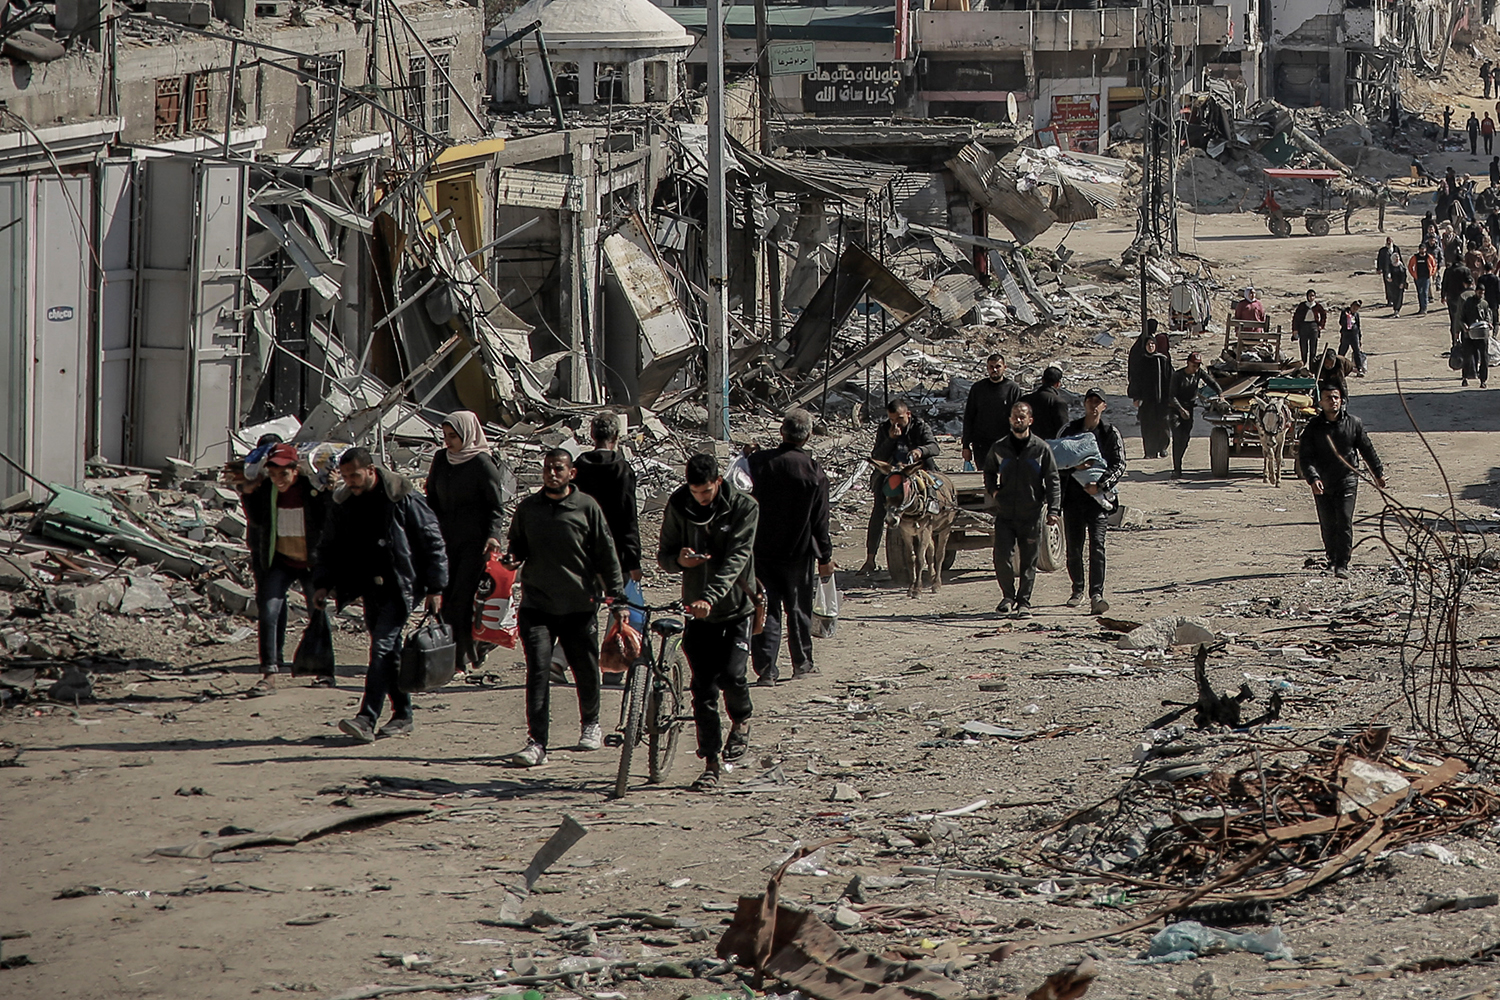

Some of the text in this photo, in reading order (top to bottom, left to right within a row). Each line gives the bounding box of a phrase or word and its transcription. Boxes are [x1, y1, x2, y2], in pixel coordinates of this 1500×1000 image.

[795, 45, 811, 54] سرقة
[794, 57, 808, 66] حرام
[864, 66, 902, 84] حلويات
[815, 84, 896, 105] زكريا ساق الله
[48, 309, 72, 320] chicco
